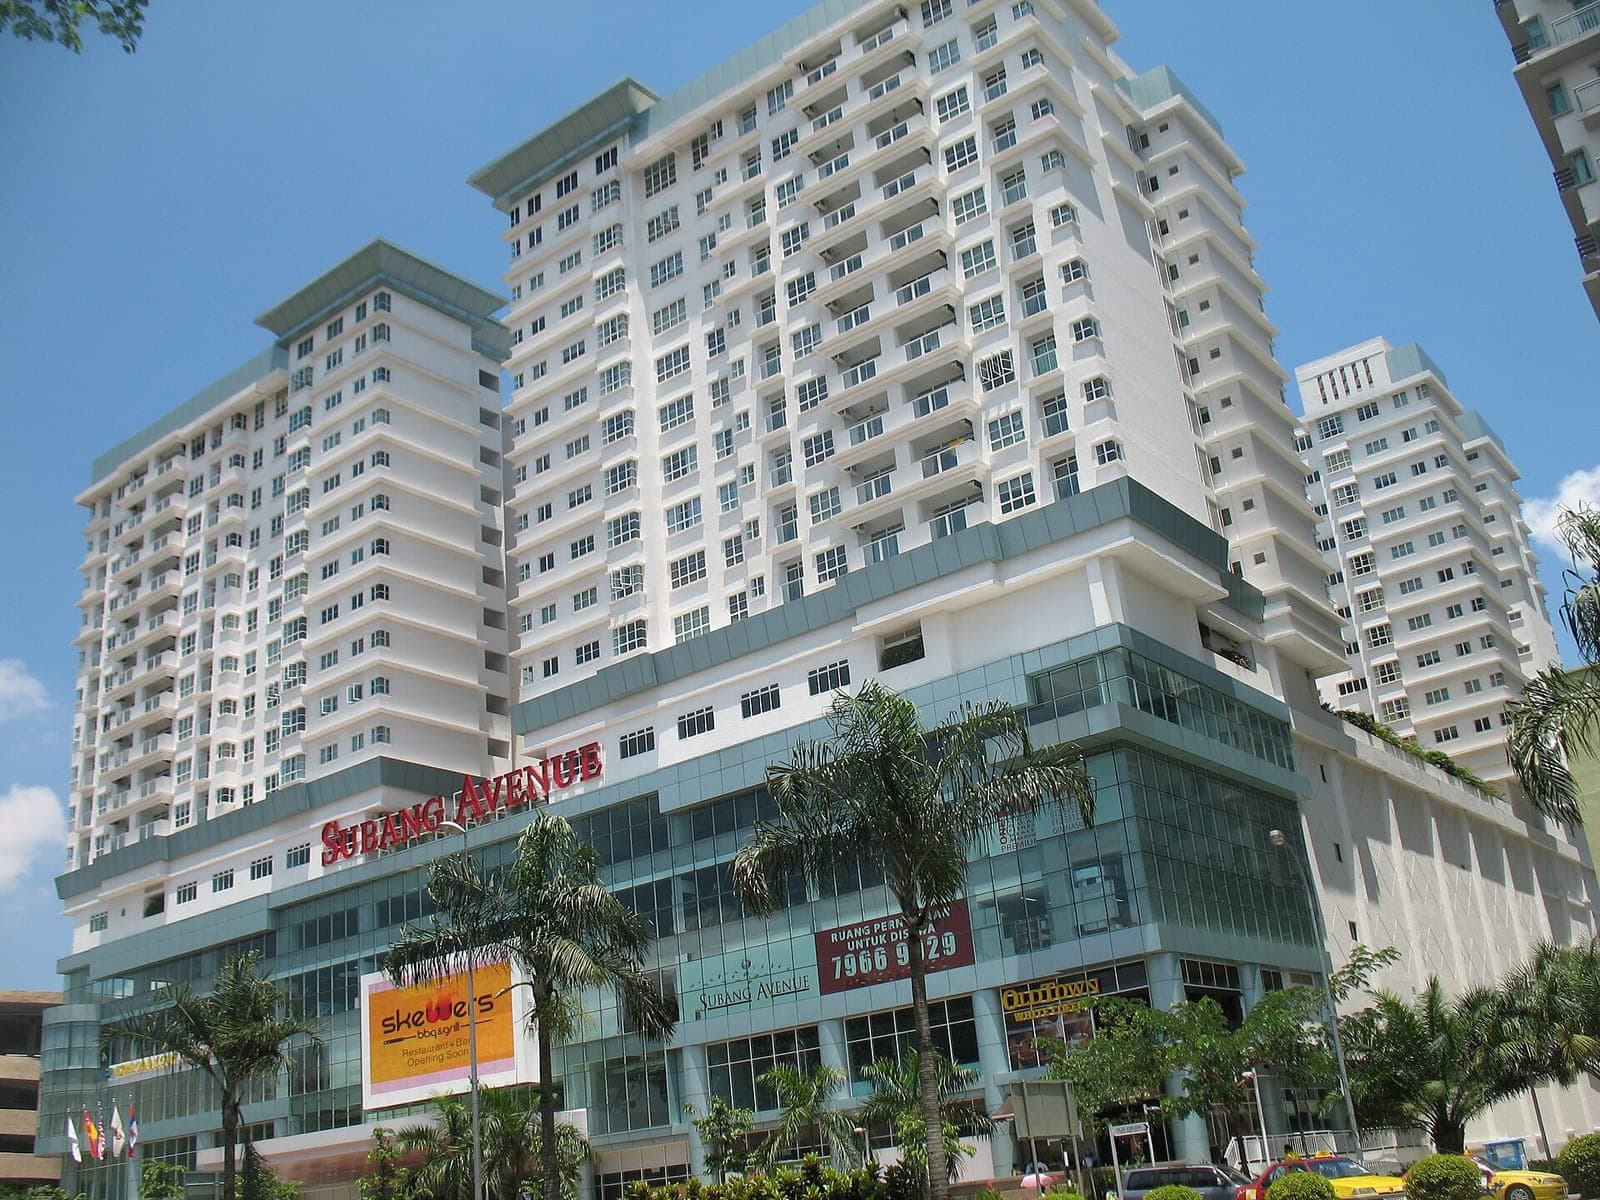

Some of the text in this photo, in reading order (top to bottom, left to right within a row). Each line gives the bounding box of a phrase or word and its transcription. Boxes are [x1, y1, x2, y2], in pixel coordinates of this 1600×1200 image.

[321, 741, 604, 867] SUBANG AVENUE
[831, 924, 871, 943] RUANG
[847, 923, 936, 951] UNTUK DISWA
[831, 931, 958, 980] 7966 929
[700, 975, 810, 1012] SUBANG AVENUE
[1014, 1008, 1050, 1022] WHITE
[407, 1048, 470, 1067] Opening Soon
